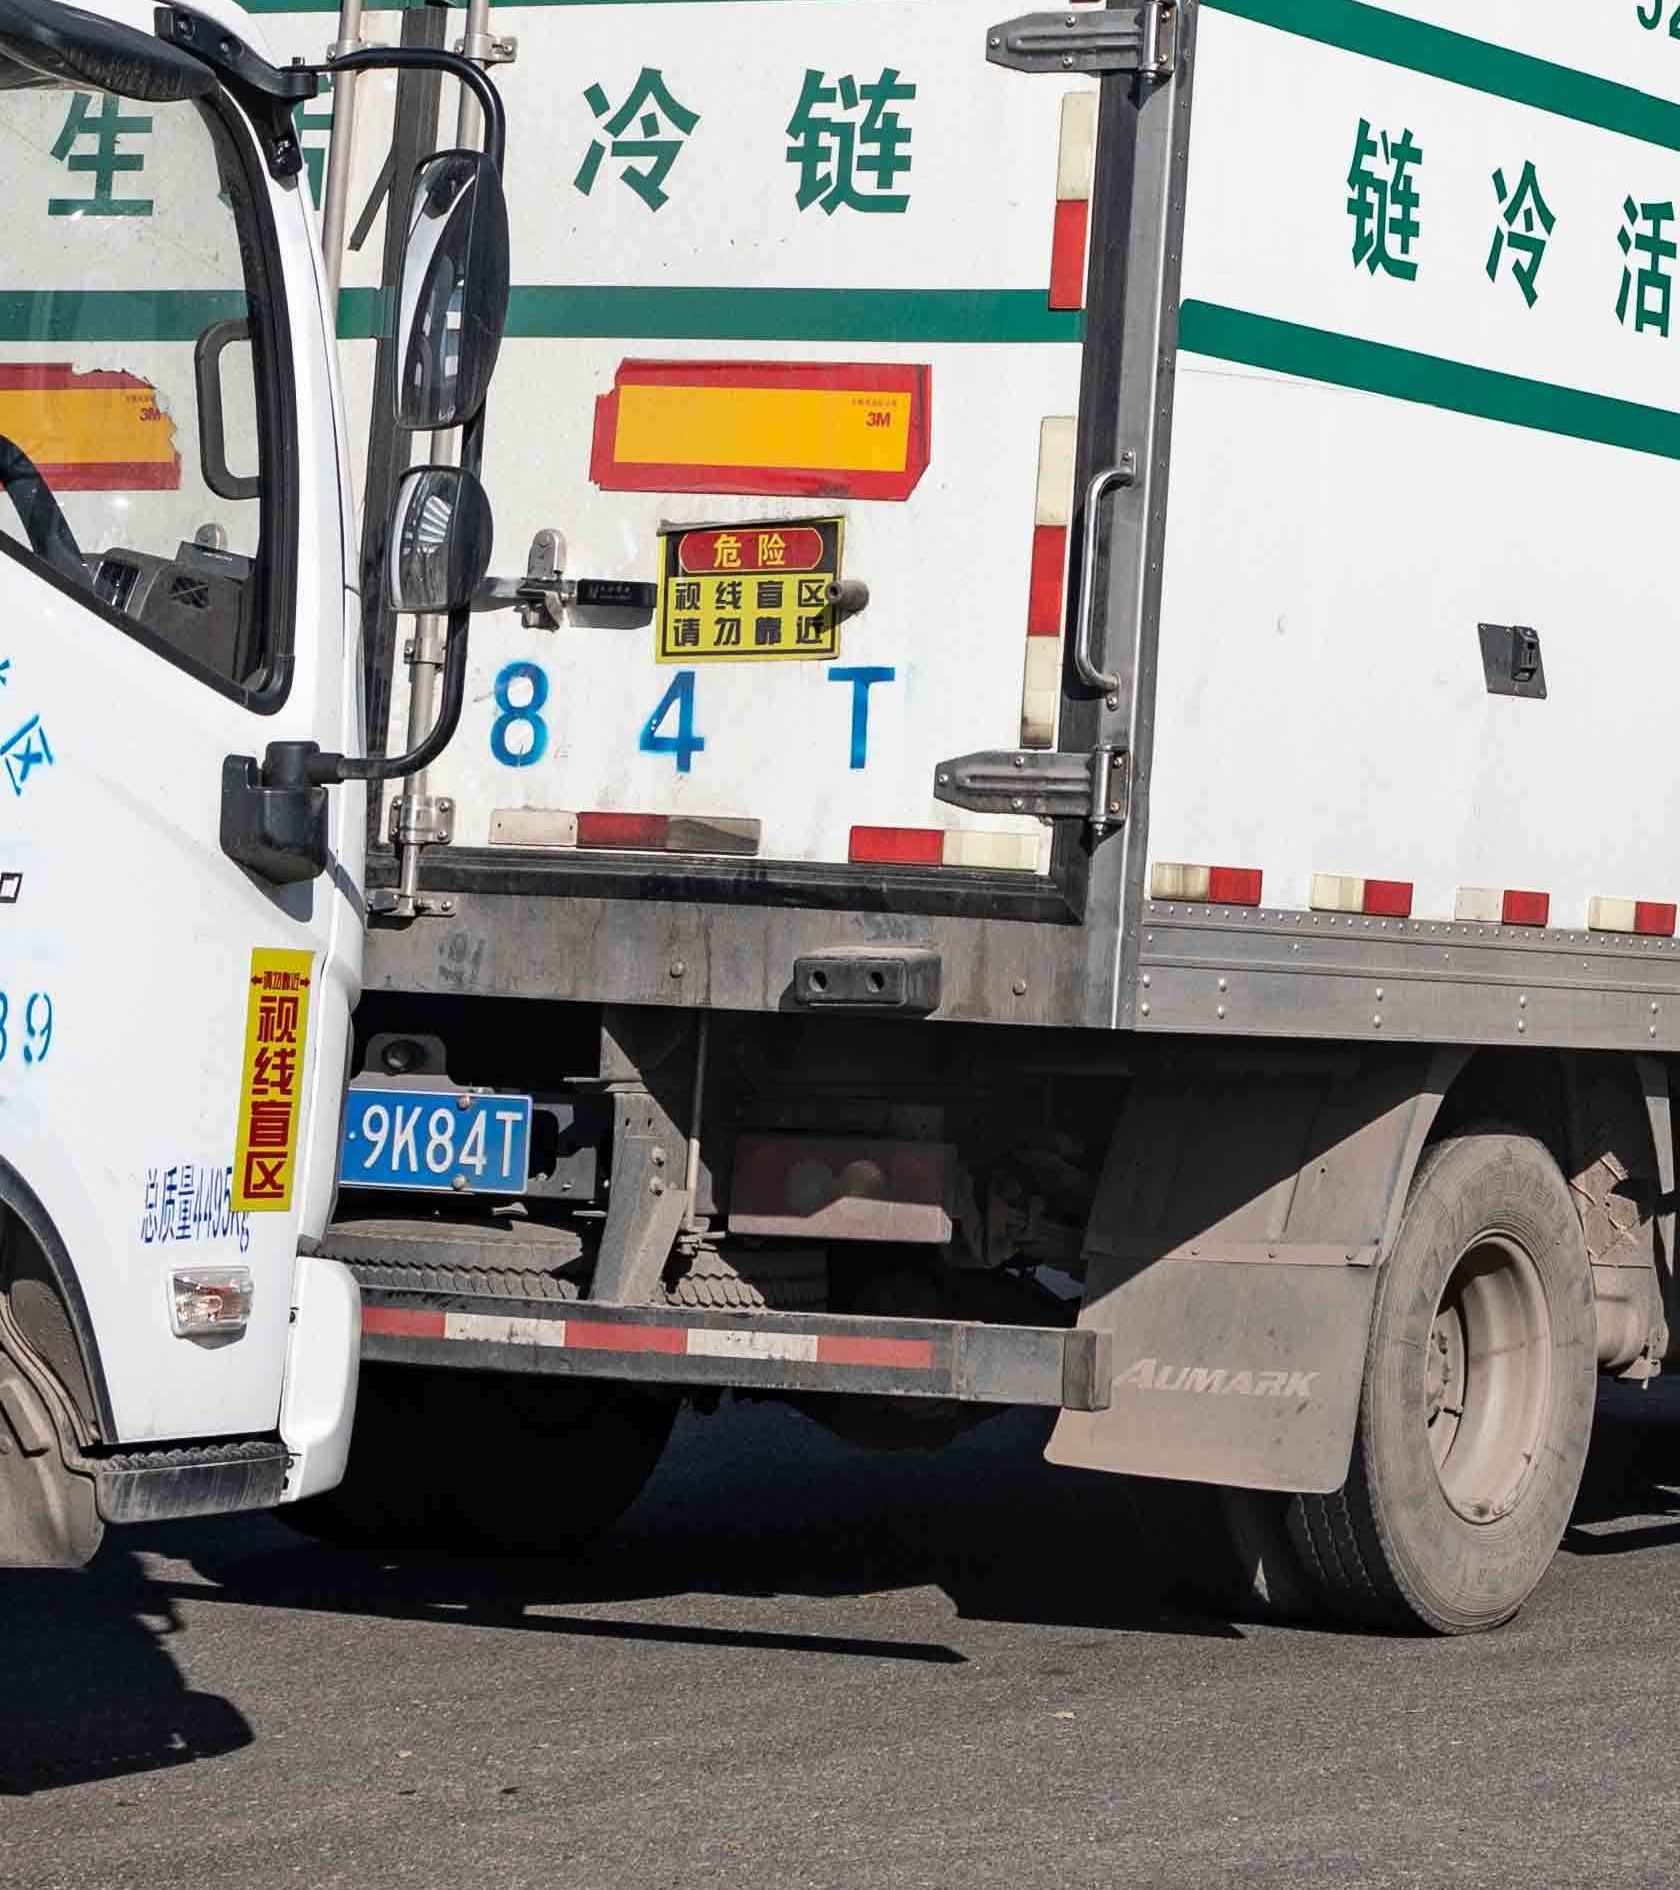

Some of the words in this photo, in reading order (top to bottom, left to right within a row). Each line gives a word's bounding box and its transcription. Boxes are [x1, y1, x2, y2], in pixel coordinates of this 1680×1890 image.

[866, 412, 892, 428] 3M
[713, 533, 786, 568] 危险
[674, 578, 826, 610] 视线盲区
[673, 615, 825, 647] 请勿靠近
[243, 994, 300, 1199] 视线盲区
